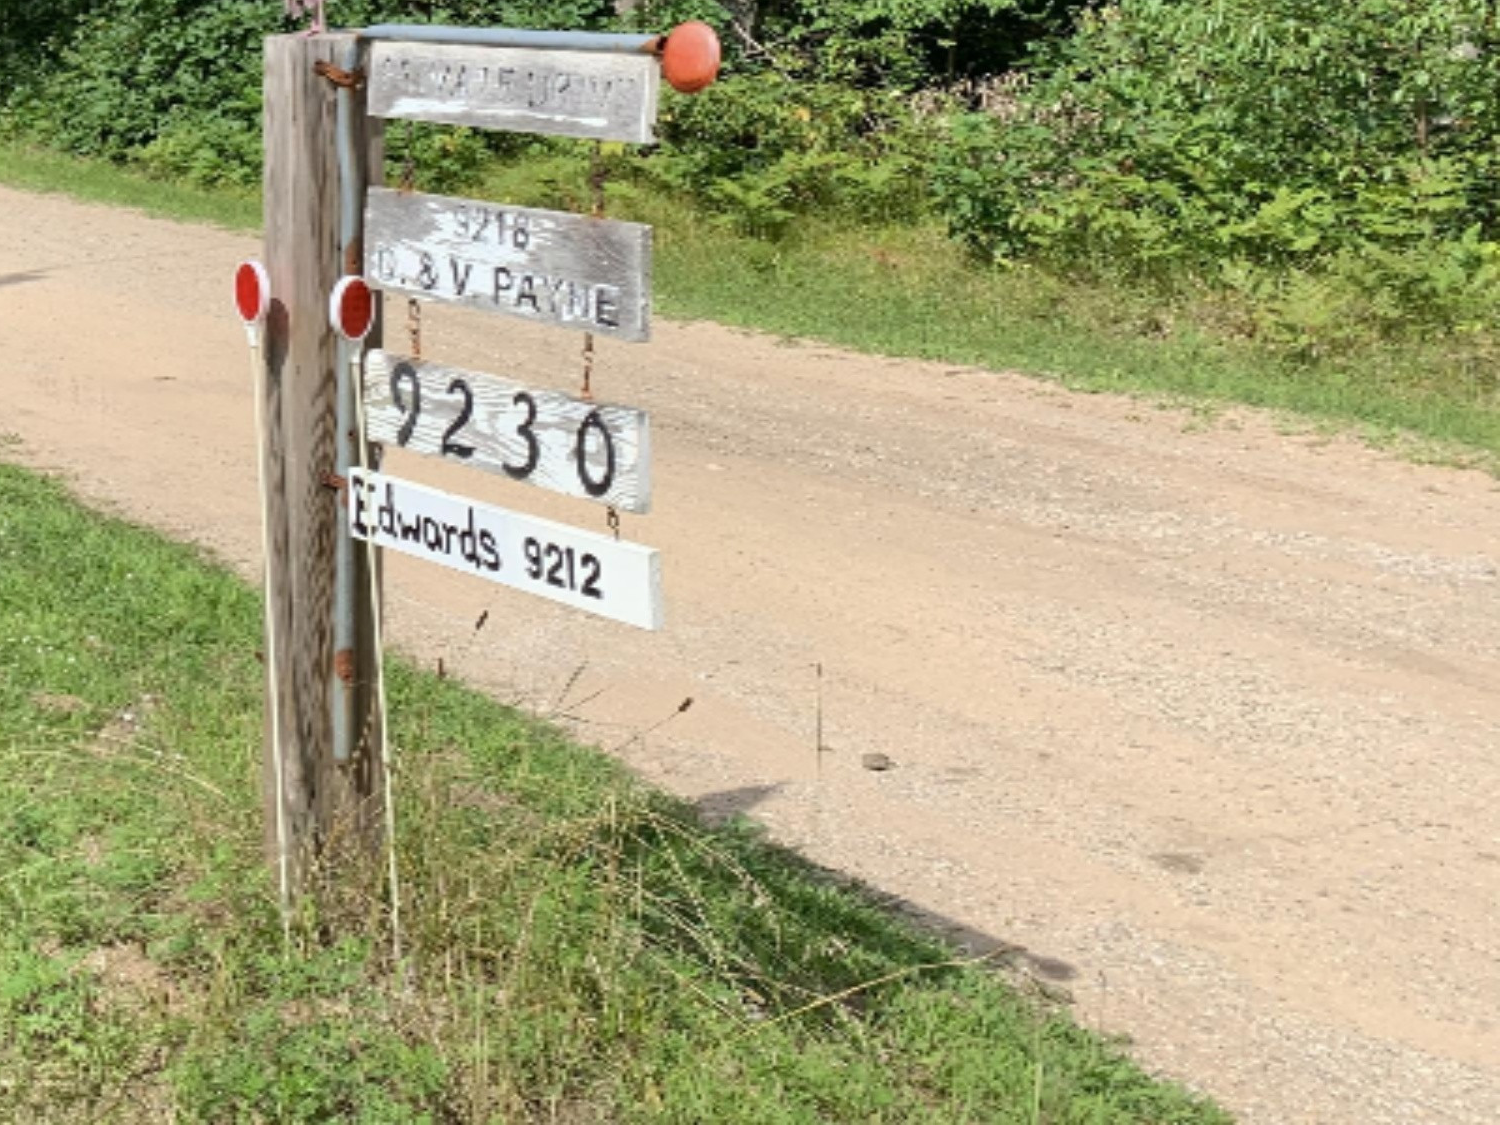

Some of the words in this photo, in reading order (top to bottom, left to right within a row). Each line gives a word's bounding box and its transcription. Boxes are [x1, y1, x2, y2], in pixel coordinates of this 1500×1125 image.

[422, 251, 441, 291] &
[493, 266, 620, 327] PAYNE
[391, 362, 616, 498] 9230
[352, 475, 500, 571] Edwards
[525, 536, 604, 600] 9212
